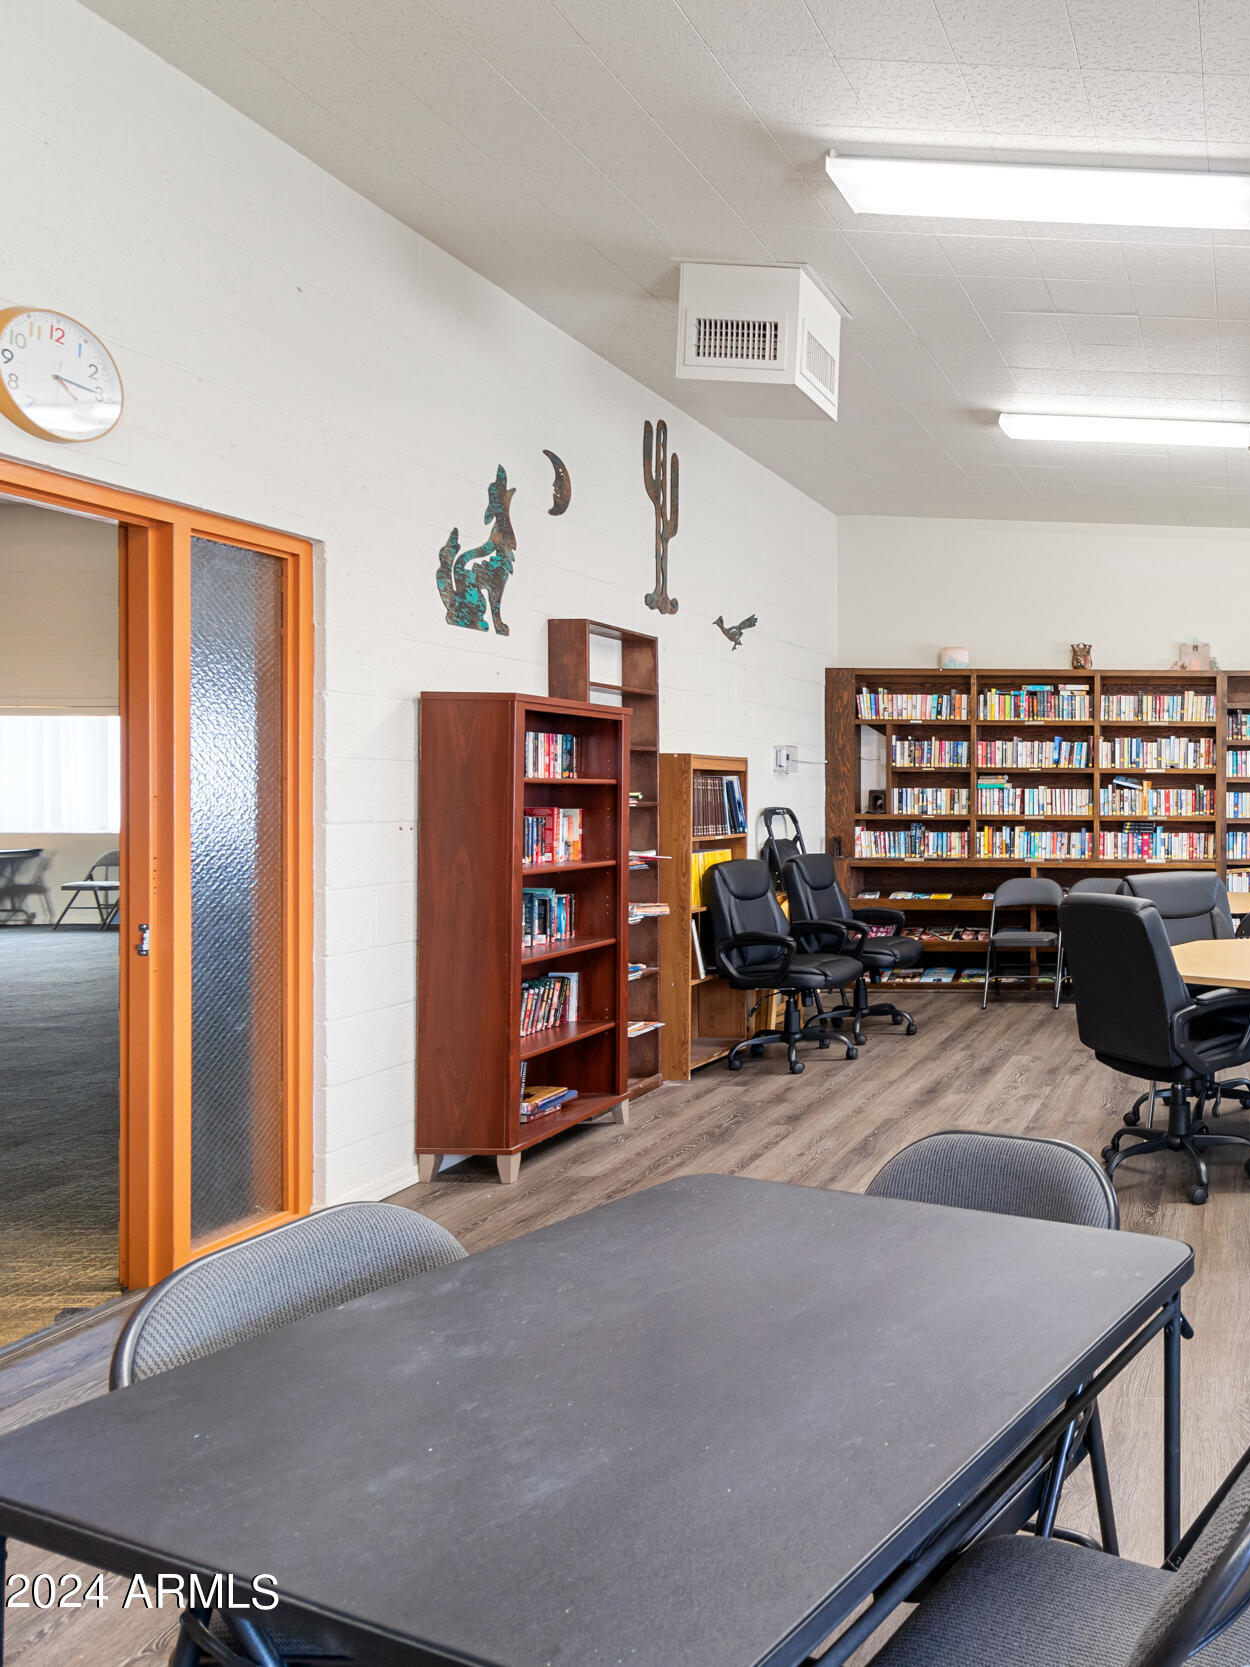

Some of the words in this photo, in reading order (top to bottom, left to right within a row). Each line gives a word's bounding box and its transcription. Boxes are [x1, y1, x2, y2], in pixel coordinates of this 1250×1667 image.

[9, 329, 27, 350] 10
[29, 322, 42, 341] 11
[50, 324, 66, 346] 12
[1, 348, 15, 364] 9
[7, 372, 20, 390] 8
[88, 363, 99, 381] 2
[94, 386, 105, 402] 3
